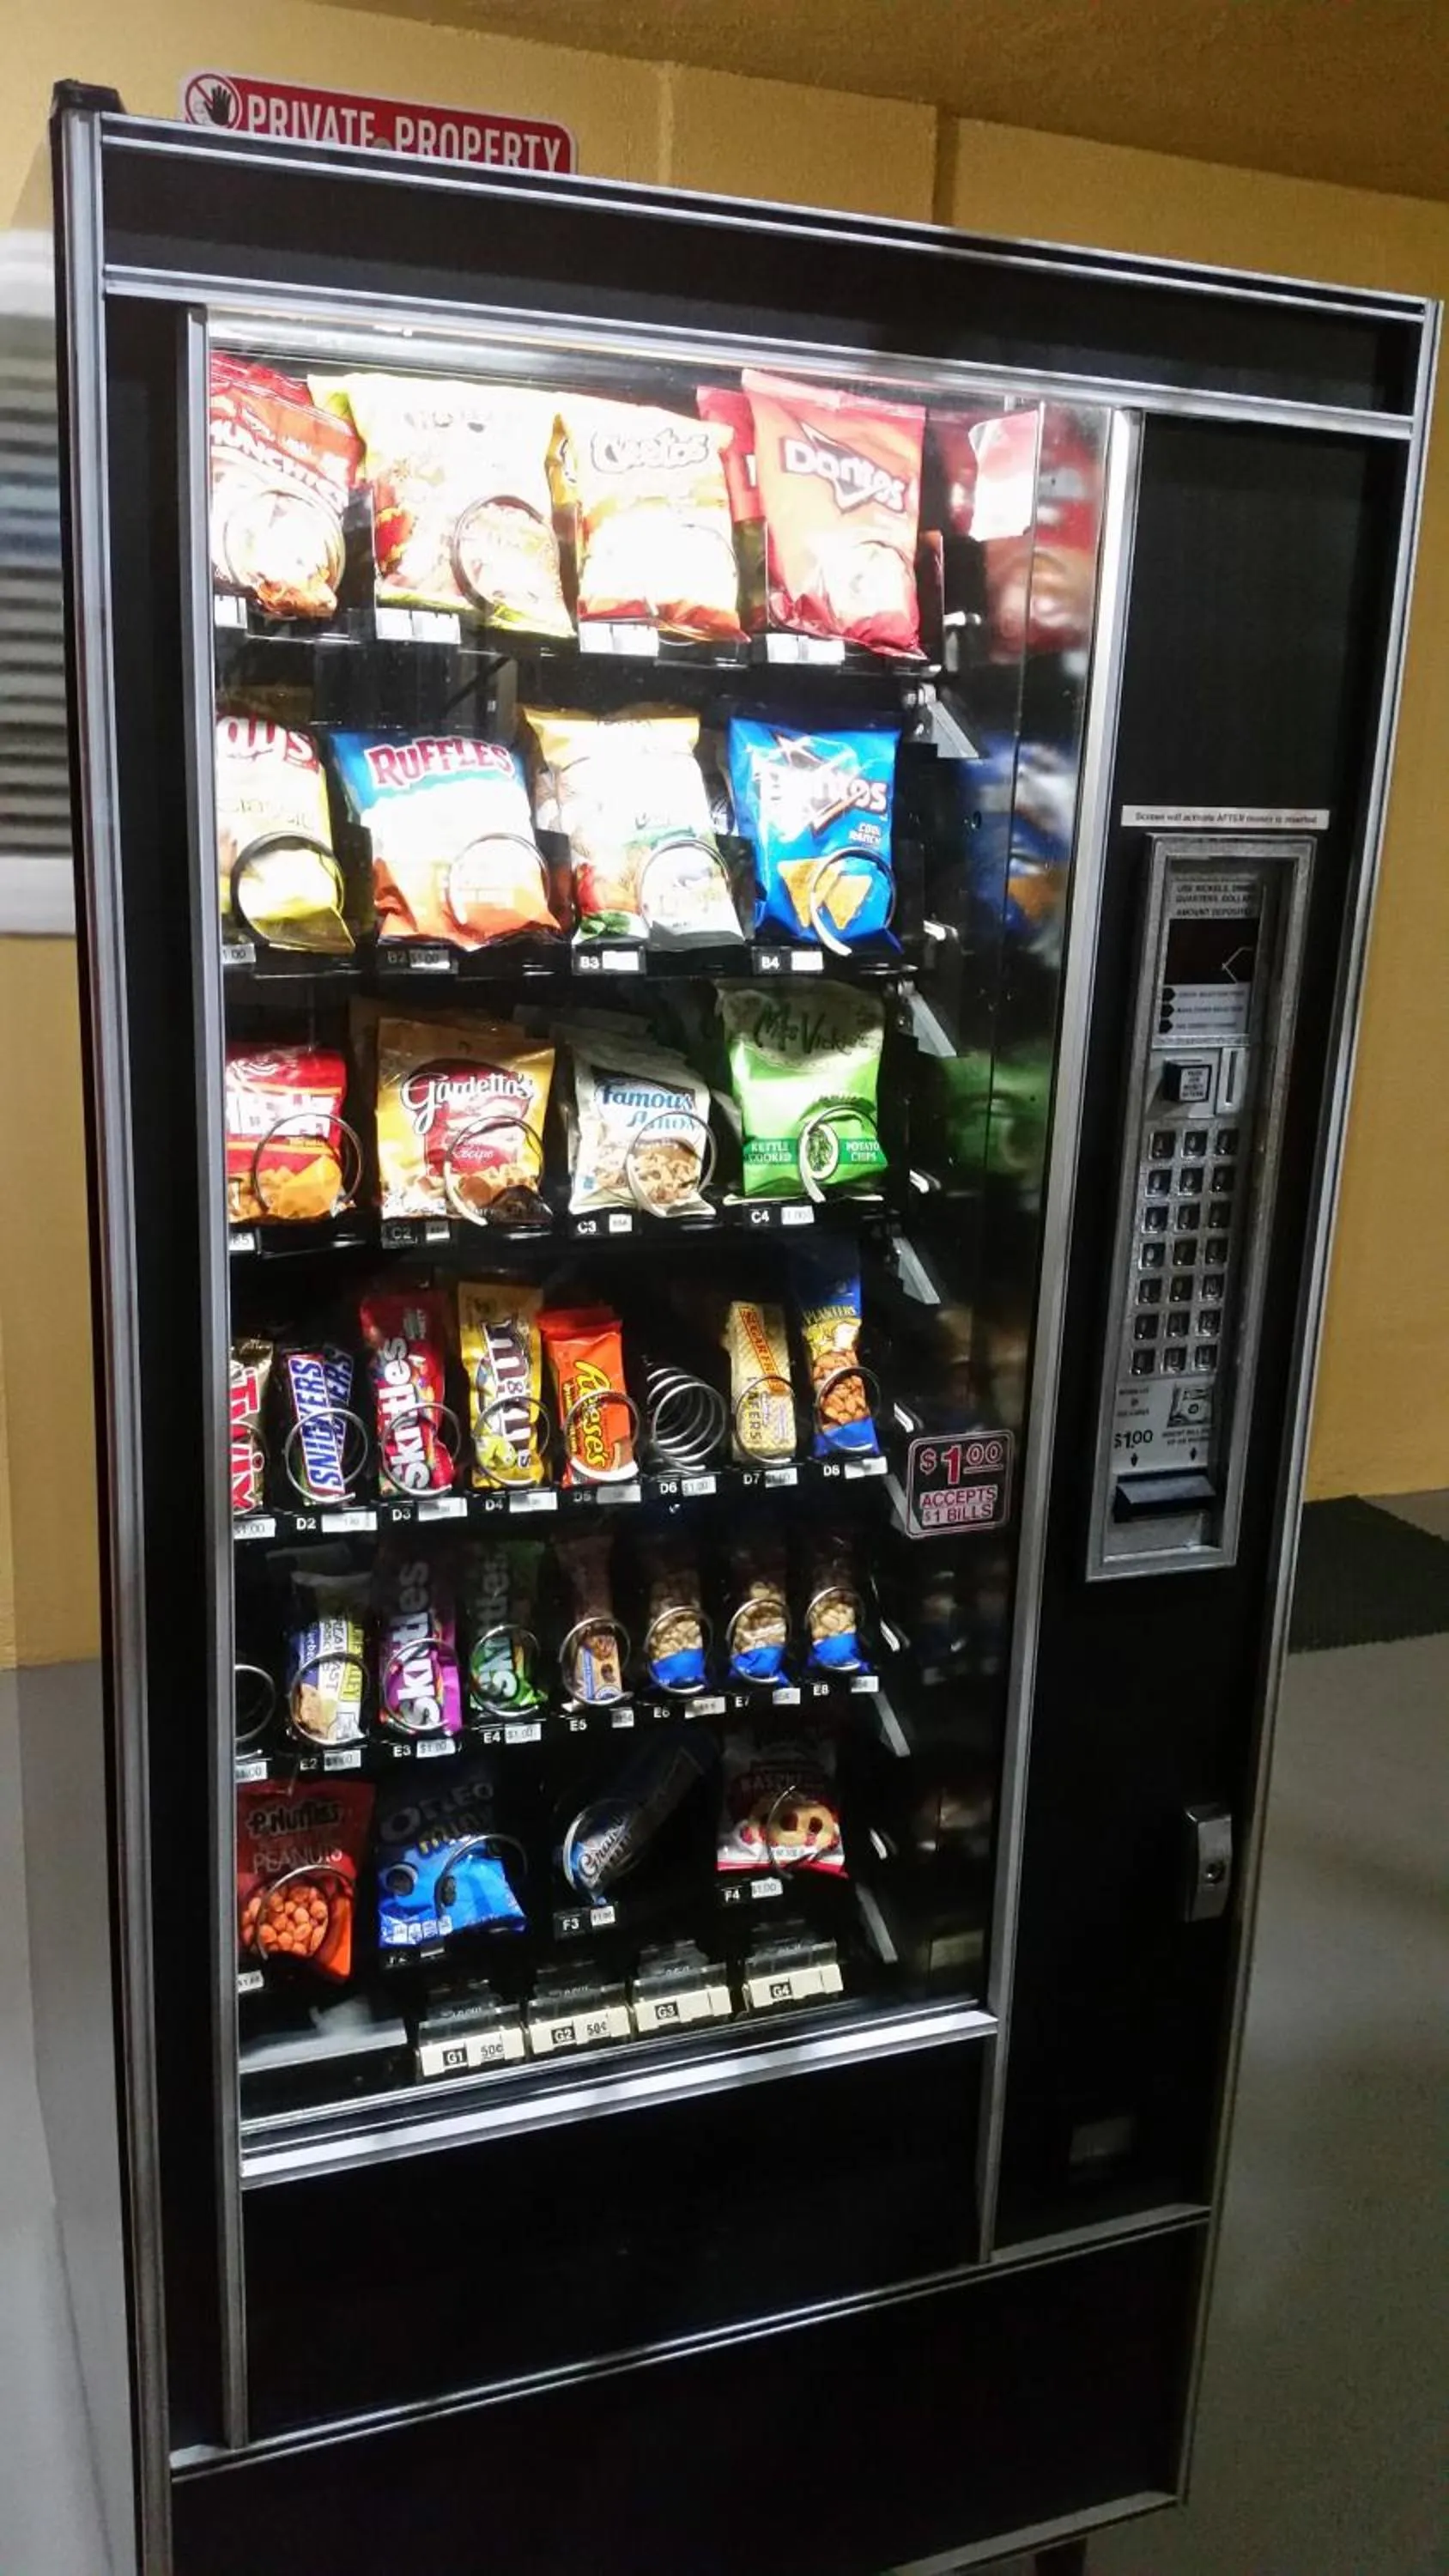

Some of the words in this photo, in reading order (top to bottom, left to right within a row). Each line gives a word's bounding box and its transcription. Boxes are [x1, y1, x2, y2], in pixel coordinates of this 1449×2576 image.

[248, 94, 375, 147] PRIVATE
[395, 117, 561, 170] PROPERTY
[782, 435, 907, 513] Doritos
[367, 736, 515, 788] RUFFLES
[579, 956, 600, 969] B3
[761, 956, 781, 969] B4
[750, 1211, 770, 1224] C4
[391, 1226, 412, 1240] C2
[577, 1220, 597, 1234] C3
[291, 1358, 344, 1490] SNICKERS
[743, 1473, 761, 1485] D7
[659, 1482, 678, 1494] D6
[921, 1486, 997, 1506] ACCEPTS
[484, 1499, 503, 1511] D4
[392, 1509, 411, 1521] D3
[947, 1504, 992, 1522] BILLS
[295, 1517, 317, 1530] D2
[812, 1684, 831, 1696] E8
[652, 1706, 671, 1718] E6
[569, 1718, 588, 1732] E5
[483, 1730, 502, 1743] E4
[392, 1745, 412, 1758] E3
[300, 1758, 318, 1771] E2
[724, 1889, 742, 1902] F4
[561, 1917, 580, 1931] F3
[773, 1984, 791, 1998] G4
[657, 2005, 676, 2020] G3
[555, 2027, 576, 2041] G2
[446, 2050, 466, 2063] G1
